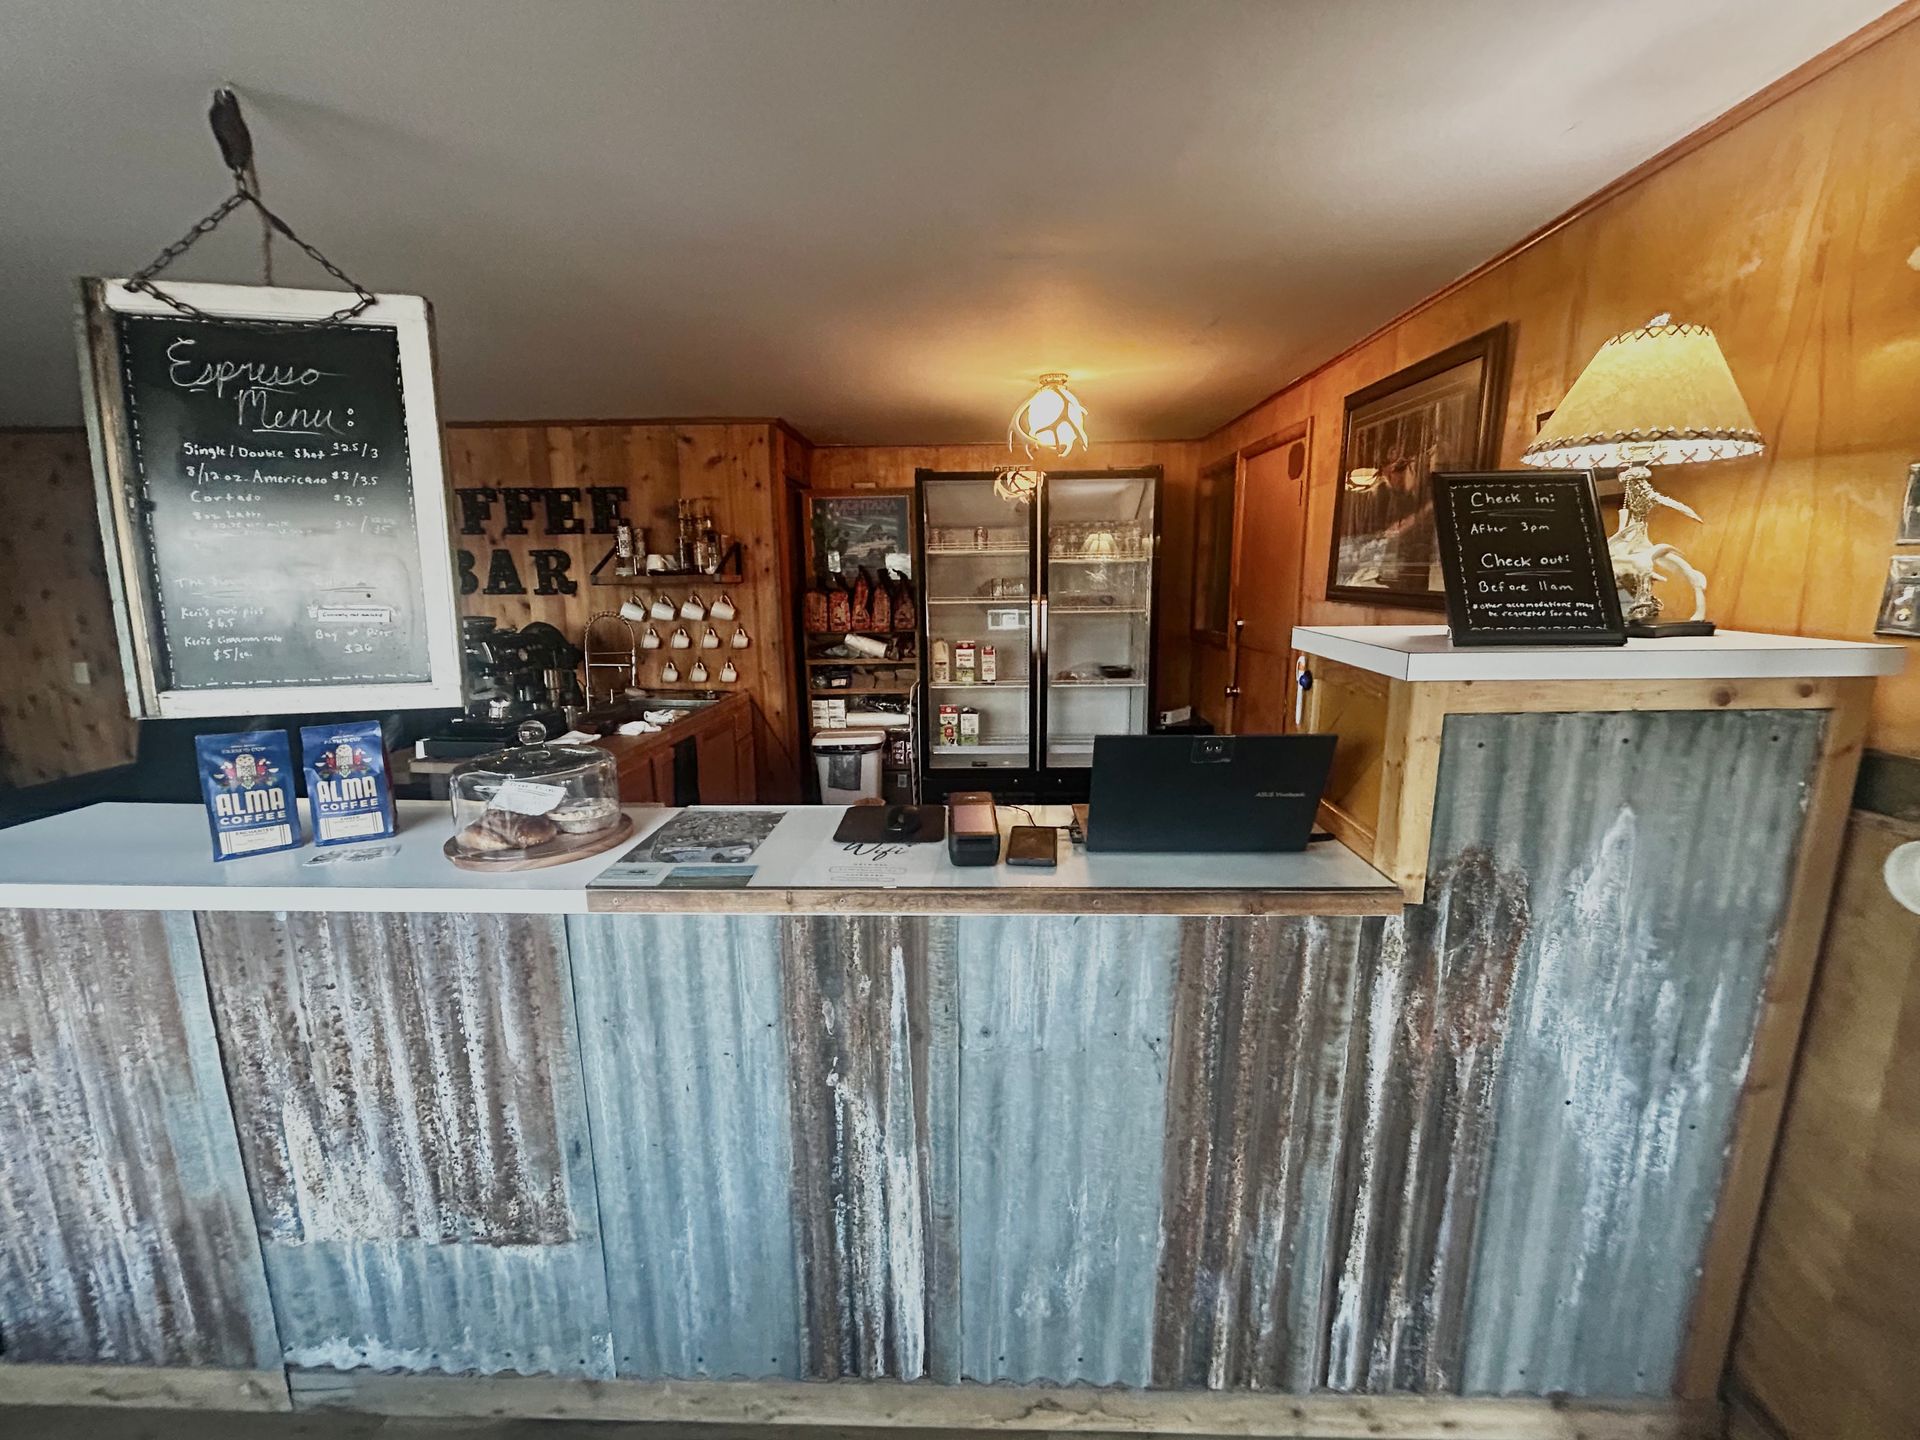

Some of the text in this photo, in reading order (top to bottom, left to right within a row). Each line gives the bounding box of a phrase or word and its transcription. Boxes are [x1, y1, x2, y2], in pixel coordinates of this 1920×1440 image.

[167, 337, 332, 398] Espresso
[294, 449, 326, 459] Shot
[252, 469, 328, 485] Americano
[190, 490, 262, 503] Cortado
[1470, 491, 1556, 507] Check in:
[455, 487, 627, 535] FFEE
[1470, 521, 1550, 535] After 3pm
[1481, 553, 1570, 568] Check out:
[458, 549, 578, 597] BAR
[1478, 580, 1530, 593] Before
[1575, 602, 1595, 611] may
[1502, 610, 1546, 619] requested
[316, 776, 378, 803] ALMA
[215, 788, 285, 816] ALMA
[320, 799, 379, 812] COFFEE
[219, 811, 287, 826] COFFEE
[843, 842, 912, 861] Wifi
